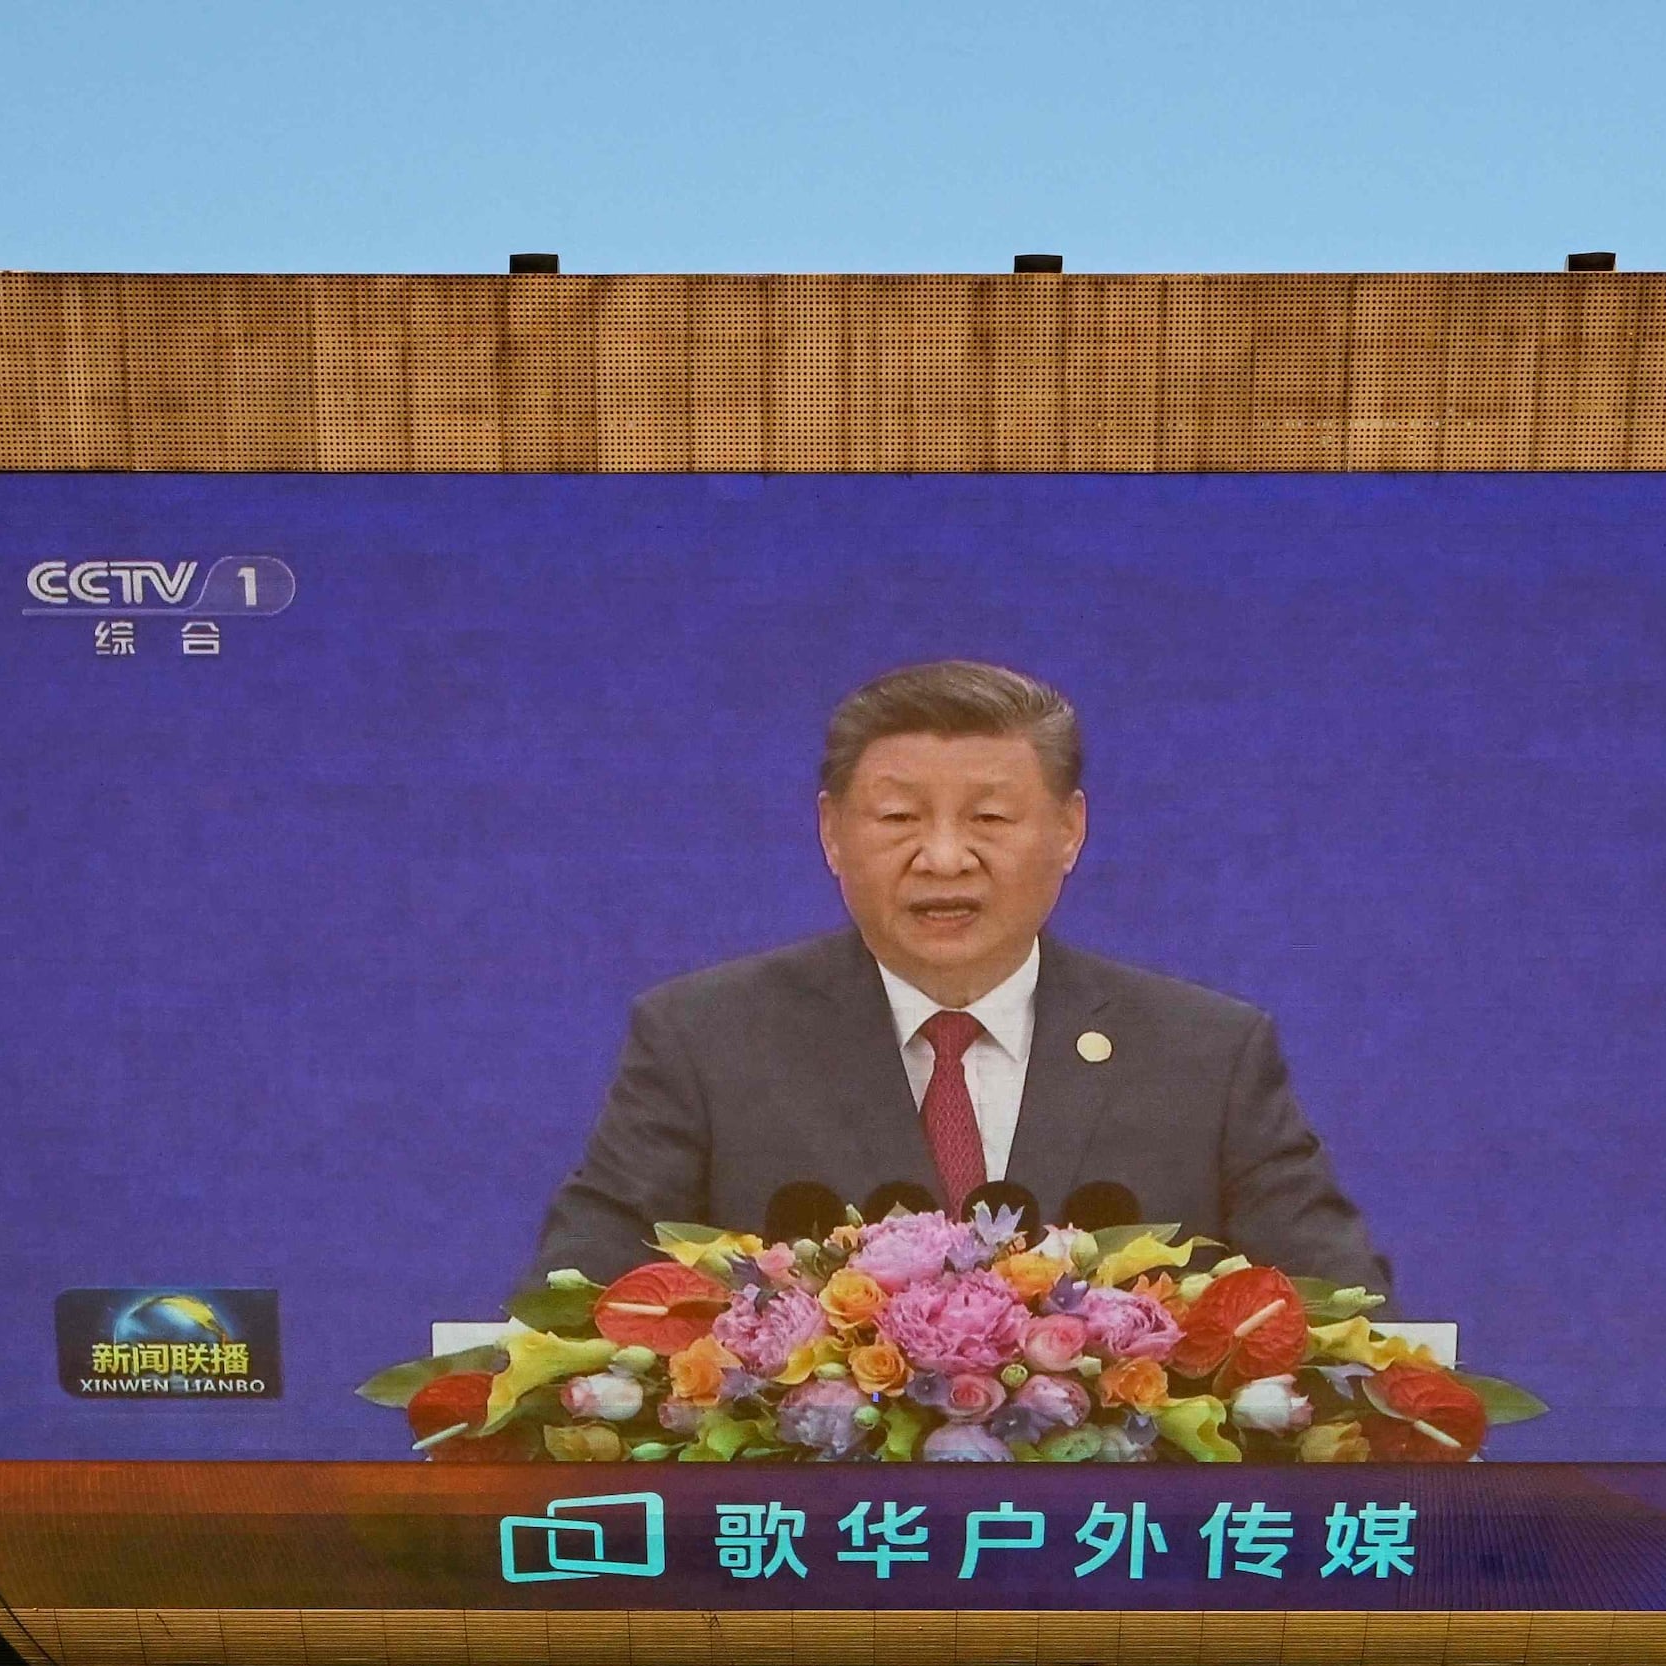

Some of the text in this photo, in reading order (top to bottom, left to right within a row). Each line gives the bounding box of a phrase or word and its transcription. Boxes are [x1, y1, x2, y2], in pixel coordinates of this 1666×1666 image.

[27, 561, 258, 606] CCTV 1
[94, 621, 220, 655] 综合
[92, 1342, 249, 1376] 新闻联播
[80, 1379, 265, 1393] XINWEN LIANBO
[714, 1500, 1416, 1580] 歌华户外传媒
